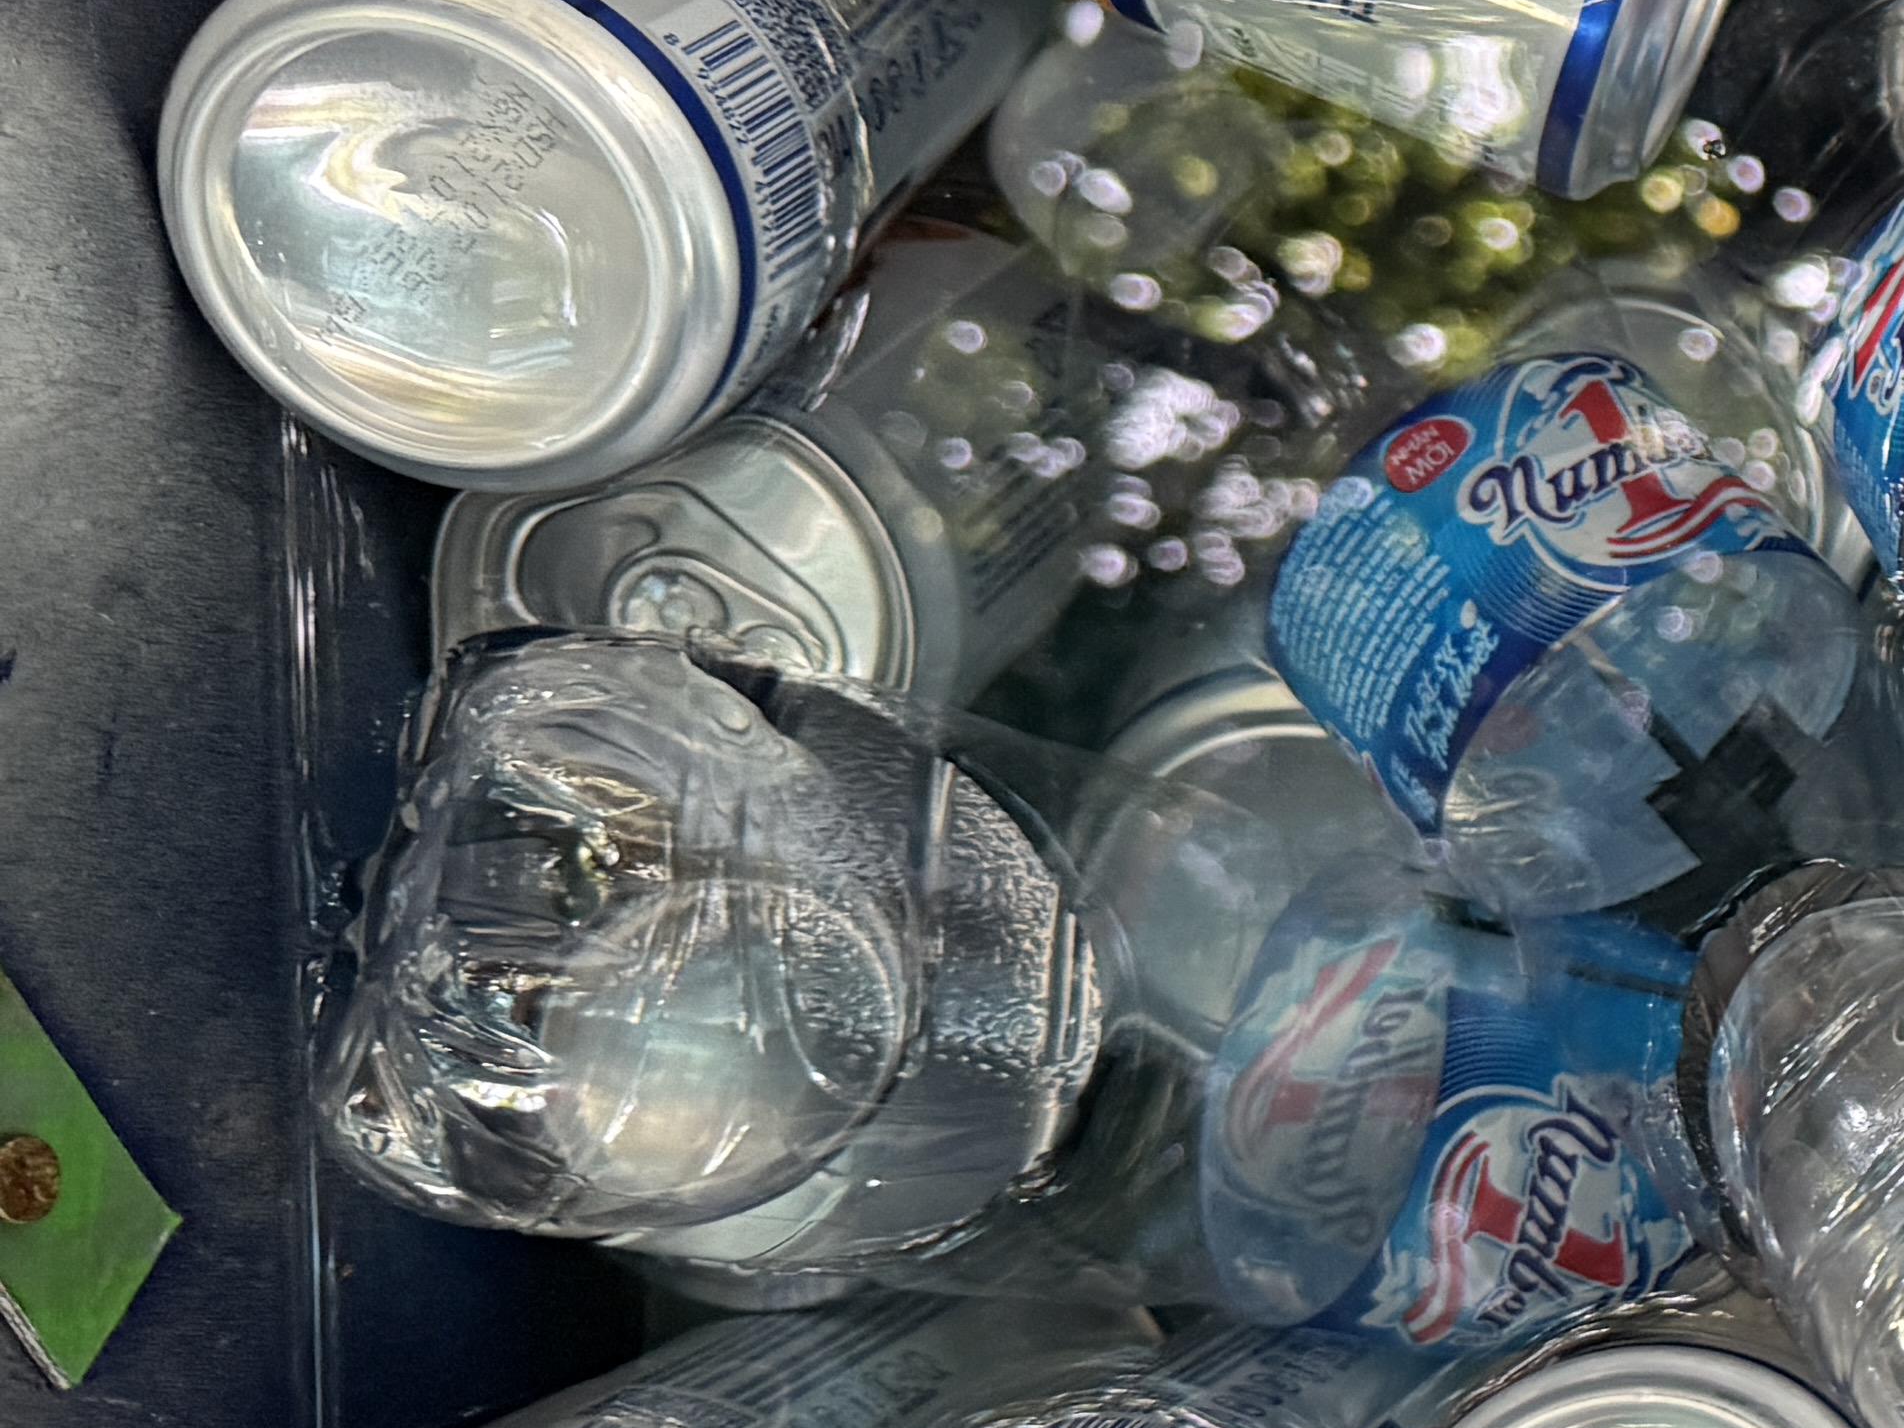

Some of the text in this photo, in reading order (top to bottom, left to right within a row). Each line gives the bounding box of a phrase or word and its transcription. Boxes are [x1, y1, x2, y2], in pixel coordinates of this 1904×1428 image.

[661, 30, 750, 148] 8 934822
[1386, 423, 1442, 468] NHÃN
[1403, 436, 1457, 484] MỚI
[1474, 1091, 1625, 1335] Number
